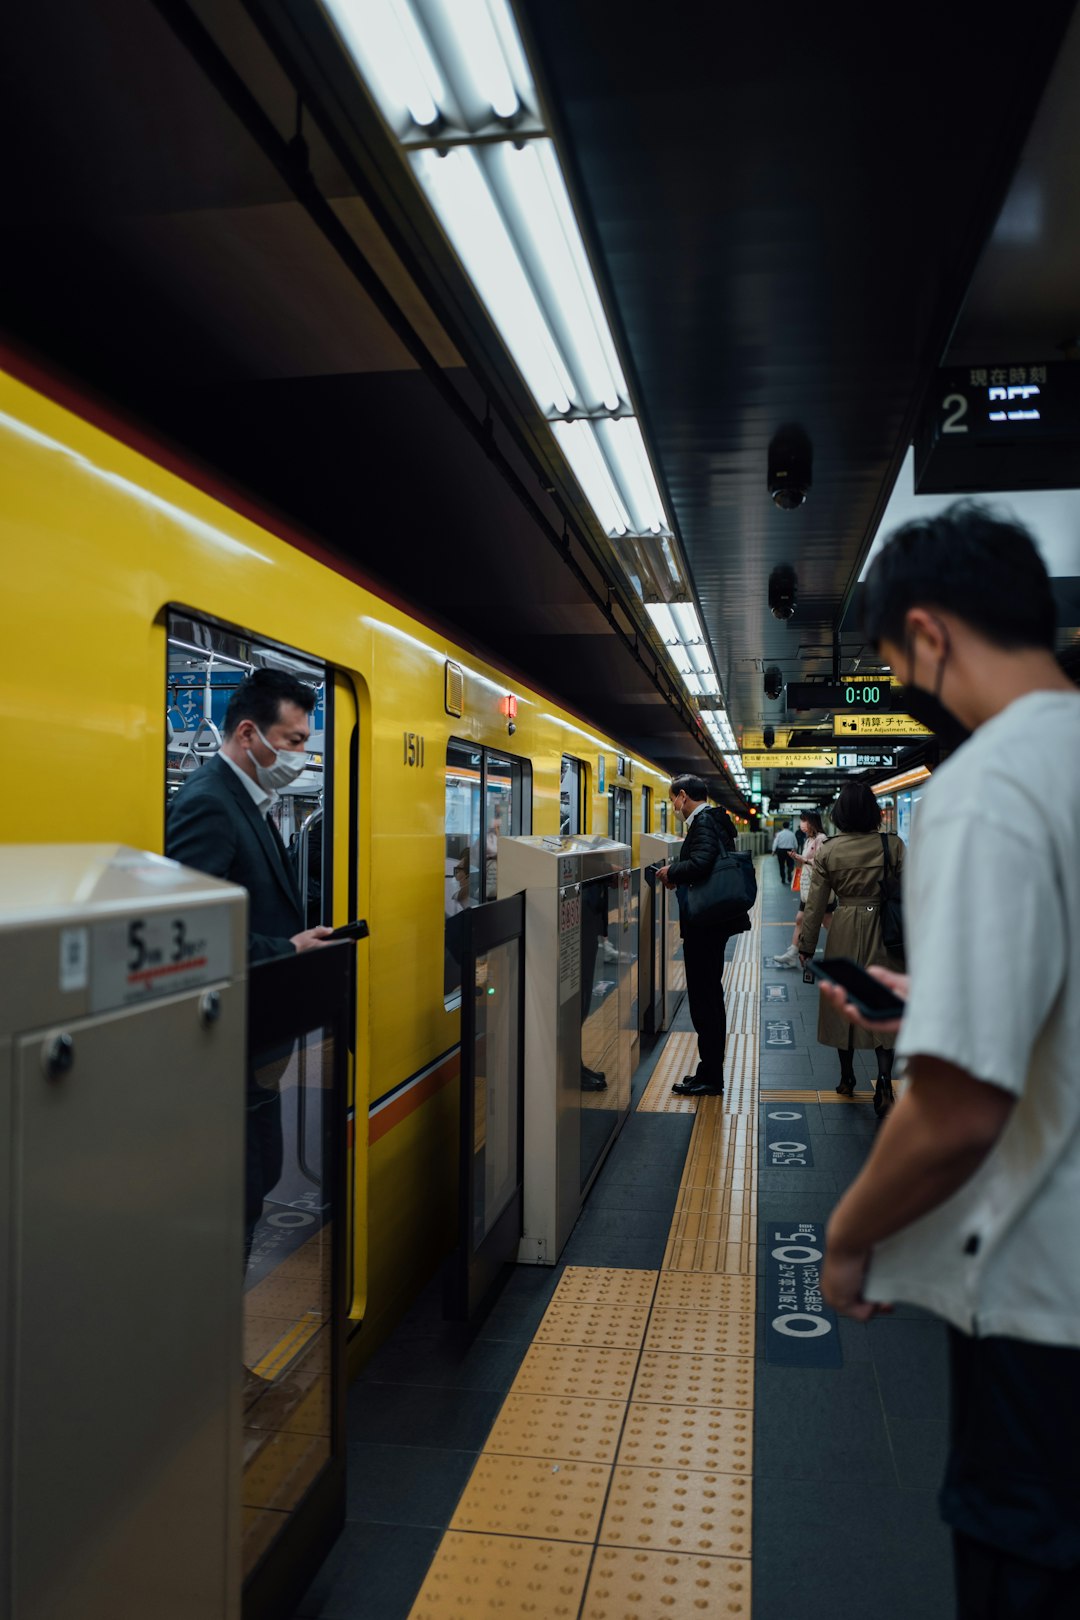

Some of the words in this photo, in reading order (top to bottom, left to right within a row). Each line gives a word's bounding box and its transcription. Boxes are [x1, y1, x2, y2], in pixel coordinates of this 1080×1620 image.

[942, 393, 968, 433] 2
[845, 686, 880, 703] 0:00
[403, 731, 424, 768] 1511
[778, 1264, 798, 1311] 2列に並んで
[802, 1264, 823, 1312] お待ちください
